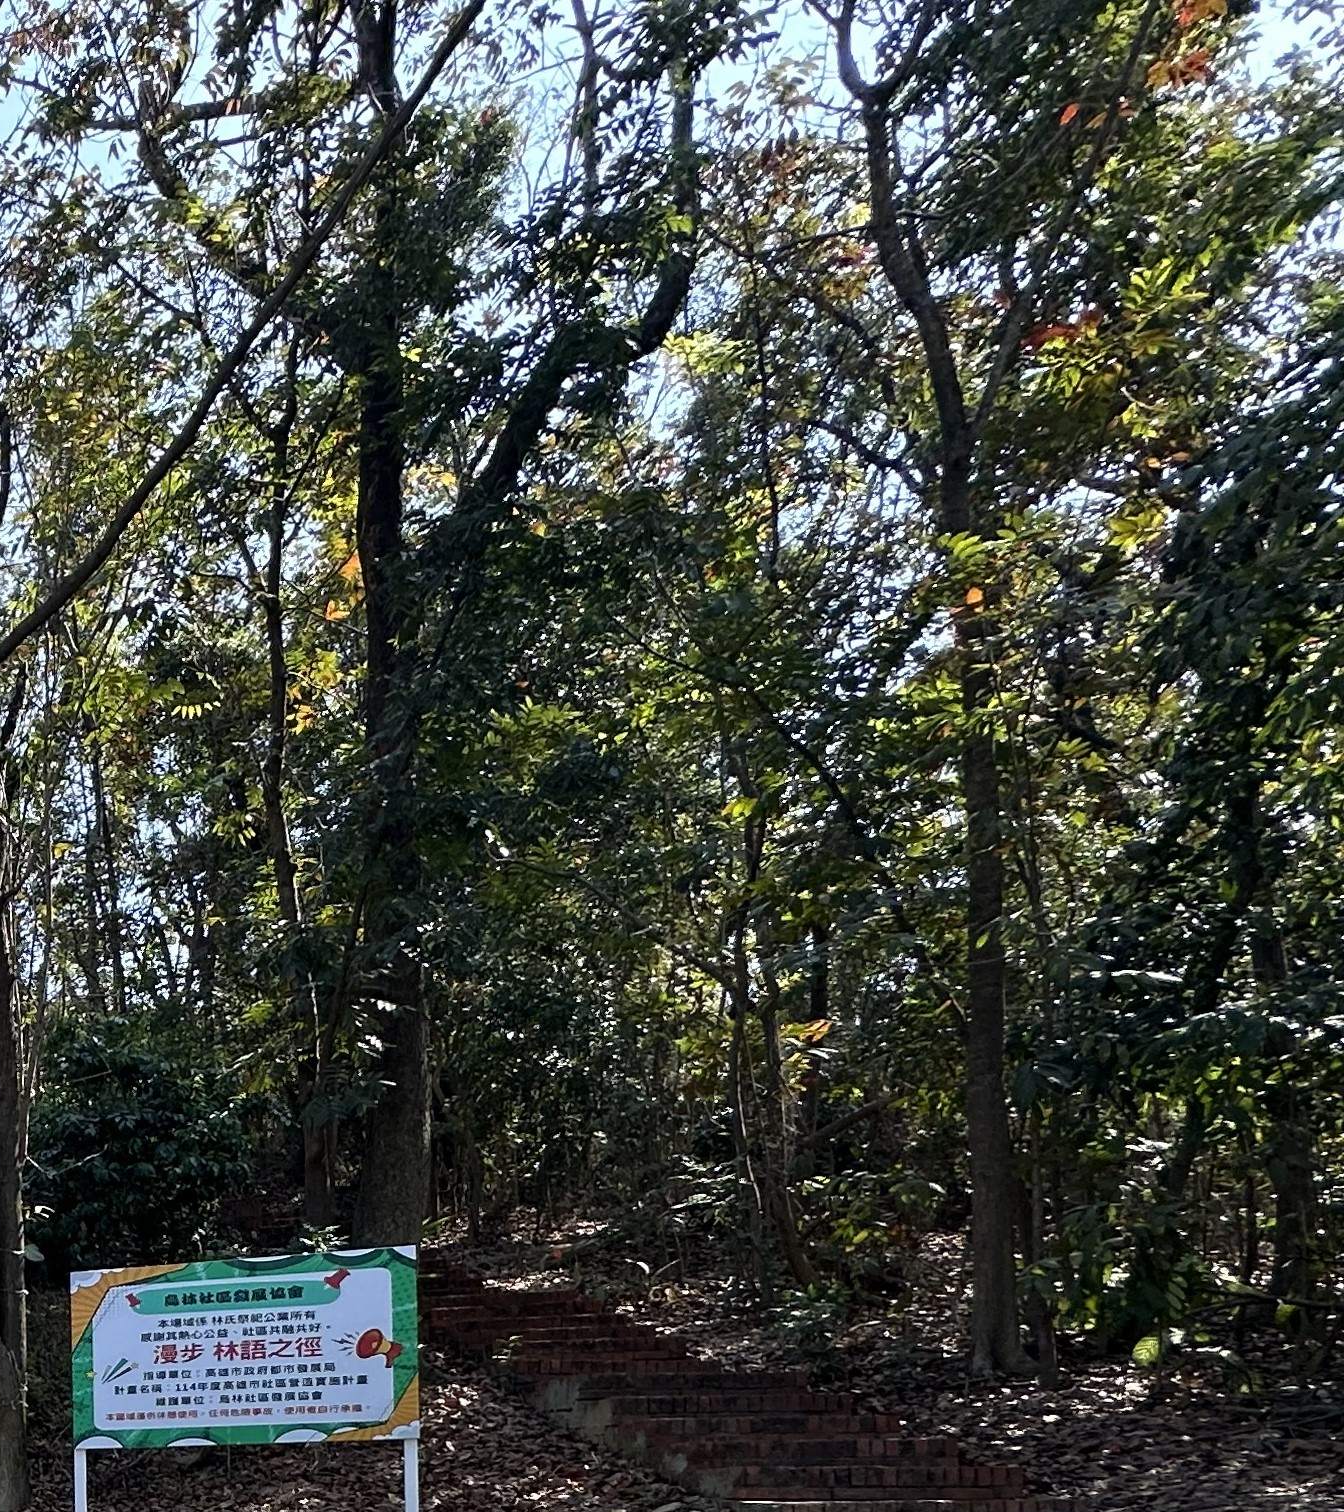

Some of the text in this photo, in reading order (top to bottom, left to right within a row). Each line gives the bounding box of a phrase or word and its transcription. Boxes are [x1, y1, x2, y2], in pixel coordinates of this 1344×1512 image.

[153, 1336, 324, 1365] 漫步 林語之徑
